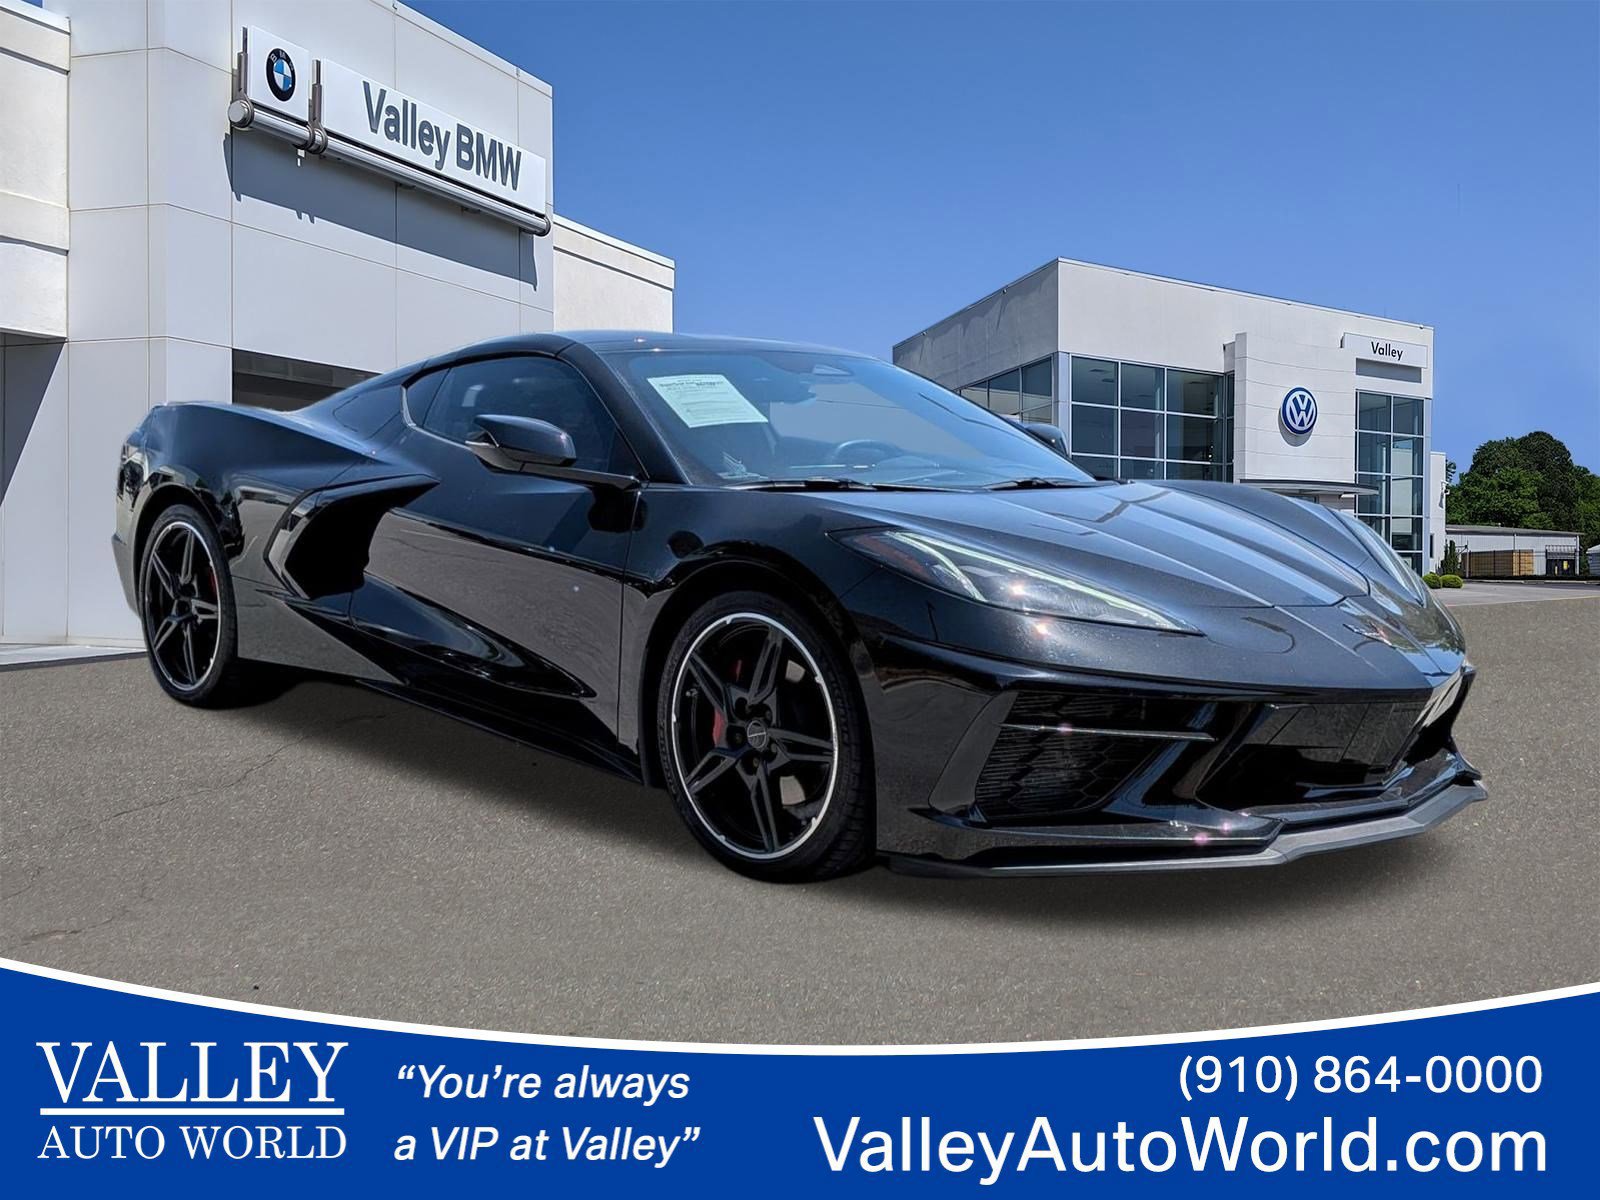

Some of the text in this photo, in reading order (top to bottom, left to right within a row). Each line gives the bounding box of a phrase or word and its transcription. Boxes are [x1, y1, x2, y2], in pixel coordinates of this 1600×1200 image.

[362, 80, 522, 191] Valley BMW
[1371, 341, 1403, 361] Valley
[1287, 392, 1316, 429] VW
